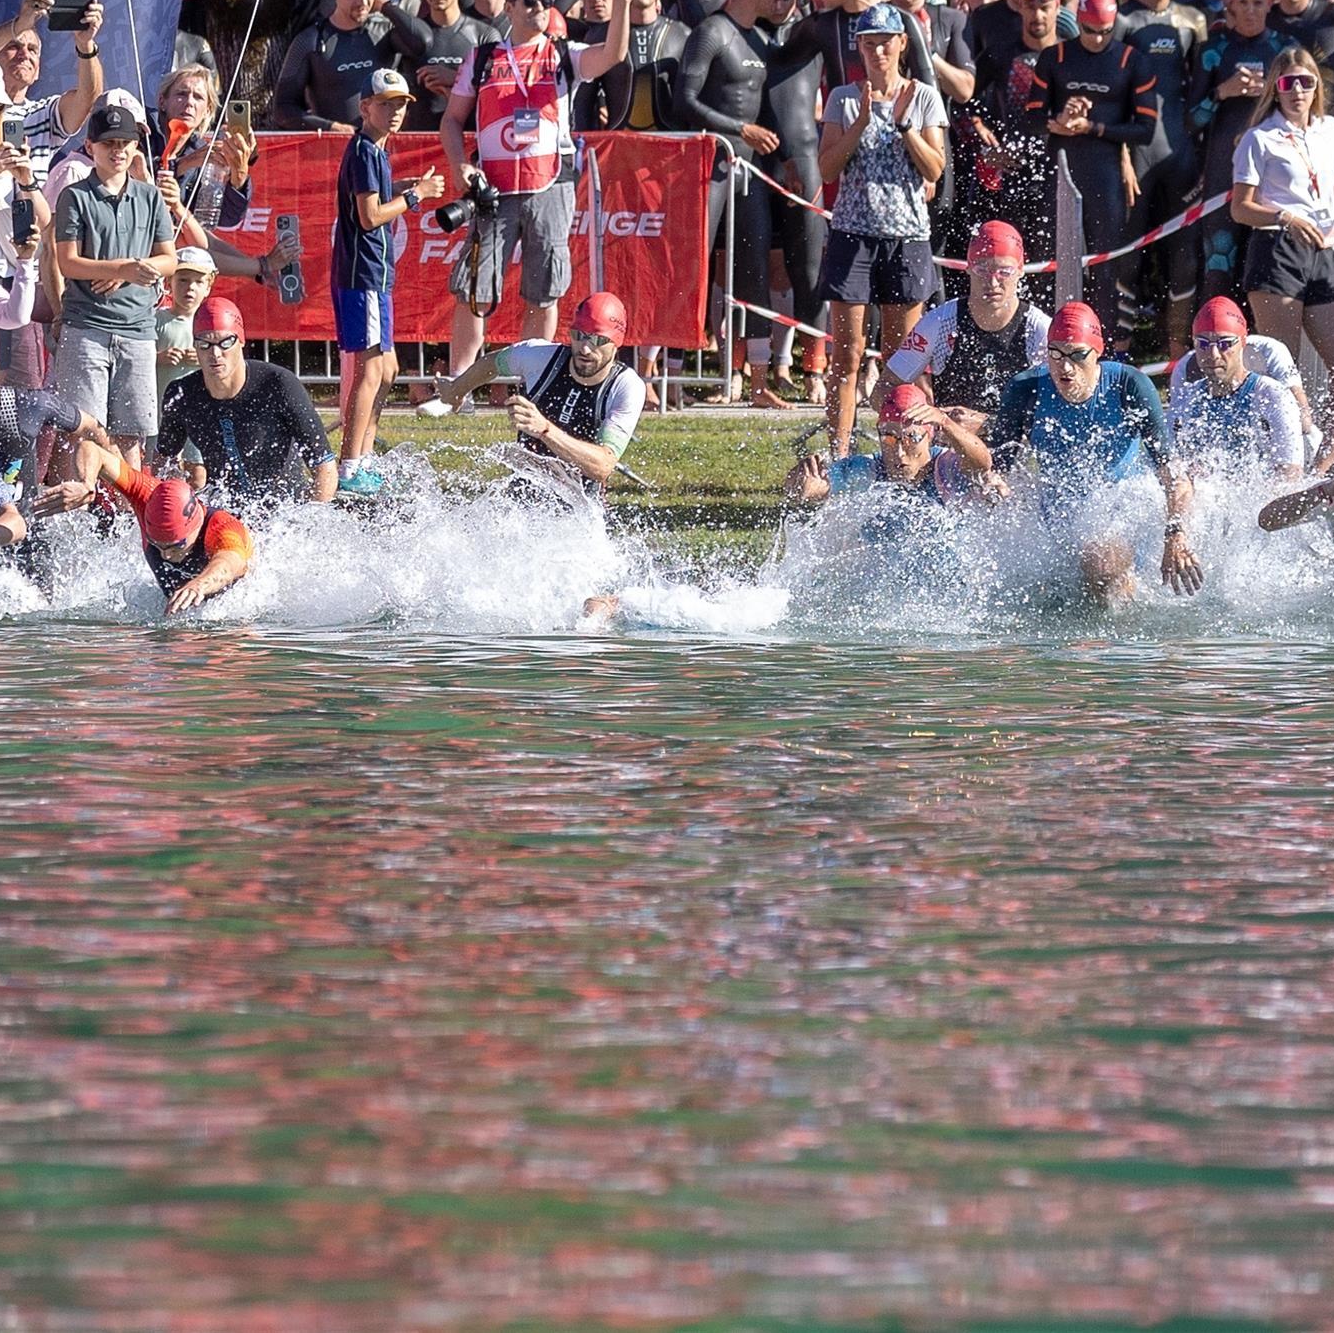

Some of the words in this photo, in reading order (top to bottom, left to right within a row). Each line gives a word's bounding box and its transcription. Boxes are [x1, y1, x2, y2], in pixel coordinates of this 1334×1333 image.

[337, 60, 373, 72] orca
[427, 56, 463, 64] orca
[1066, 81, 1110, 94] orca
[558, 388, 582, 425] HUUB
